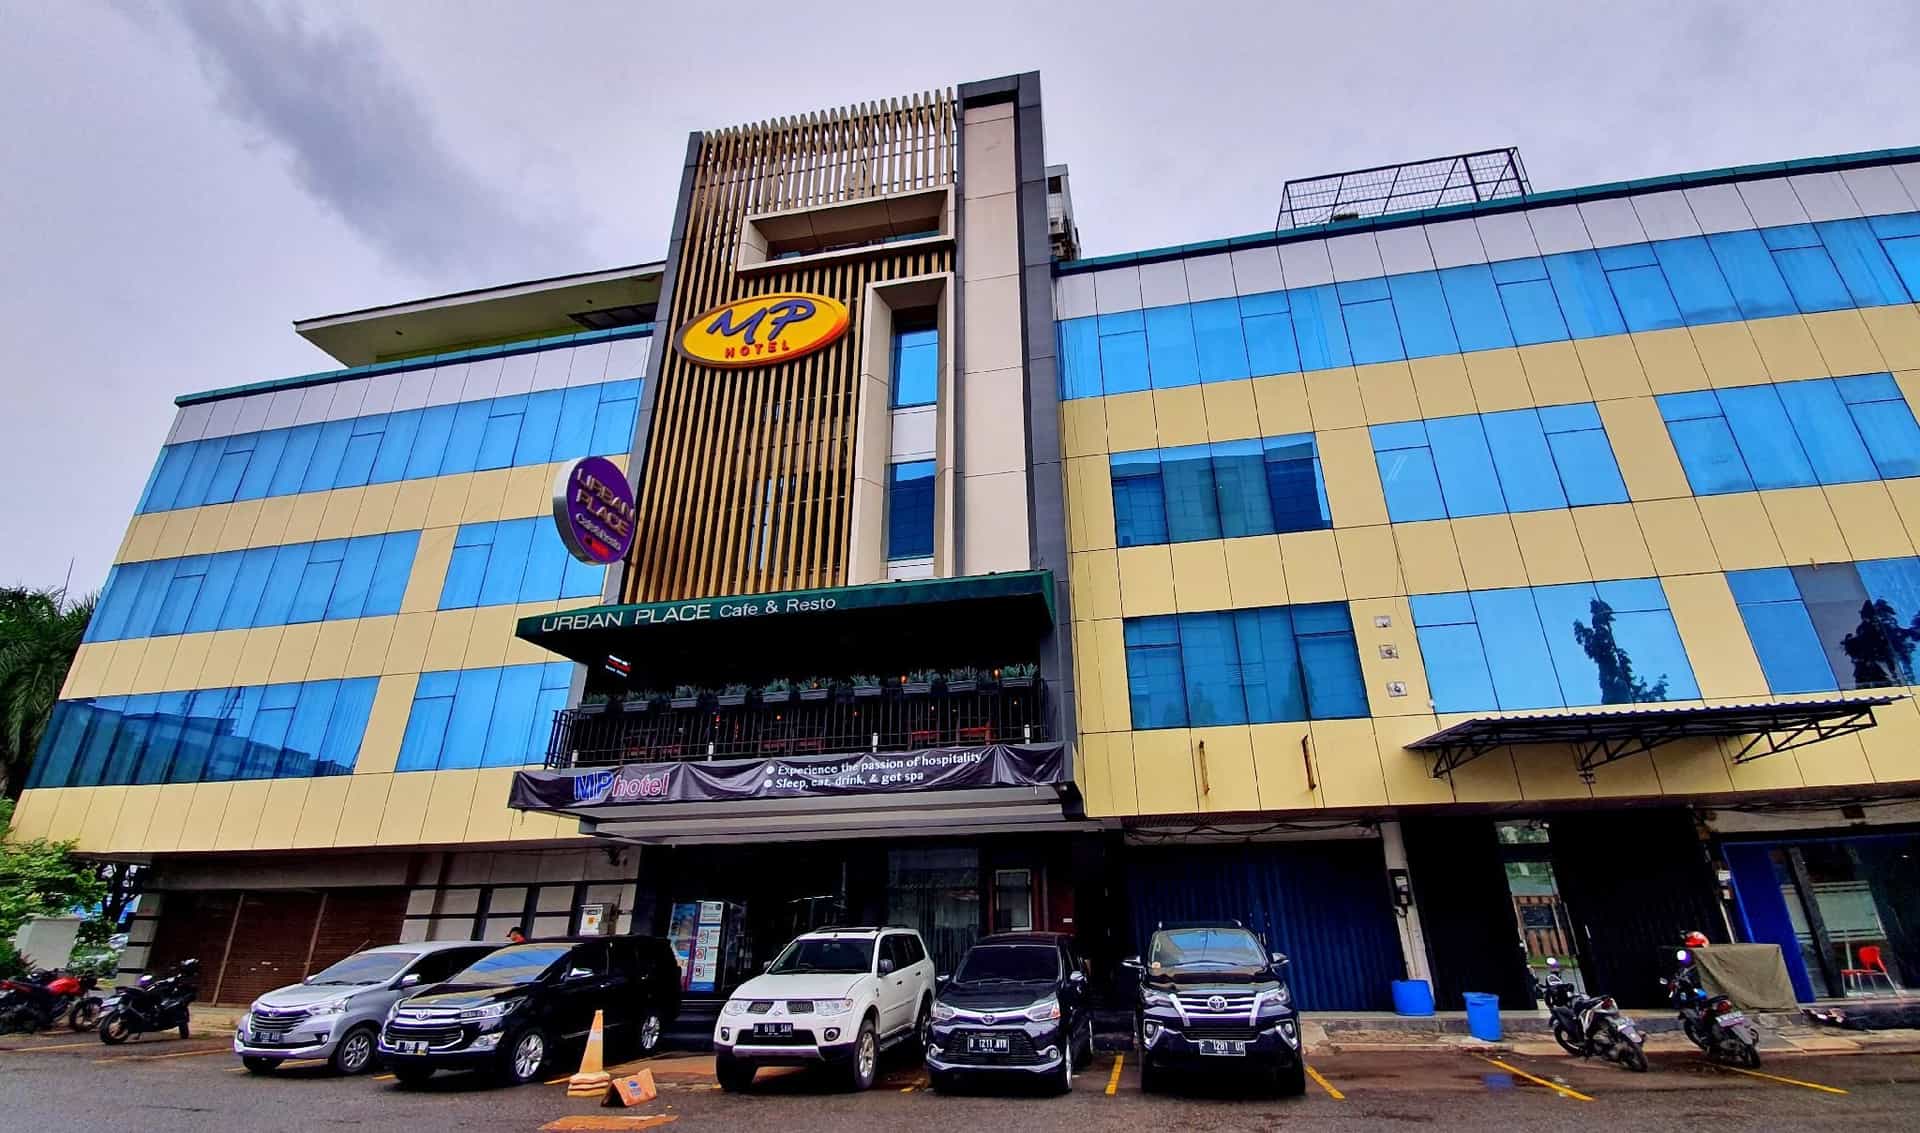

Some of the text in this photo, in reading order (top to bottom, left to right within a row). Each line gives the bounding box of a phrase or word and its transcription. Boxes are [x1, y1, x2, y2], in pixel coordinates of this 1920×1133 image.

[706, 298, 816, 344] MP
[725, 340, 790, 358] HOTEL
[577, 468, 634, 521] URBAN
[575, 488, 630, 537] PLACE
[542, 598, 836, 633] URBAN PLACE Cafe & Resto
[775, 777, 809, 790] Sleep,
[835, 774, 866, 786] drink,
[869, 775, 879, 784] &
[881, 773, 901, 785] get
[904, 771, 924, 783] spa
[778, 752, 982, 777] Experience the passion of hospitality
